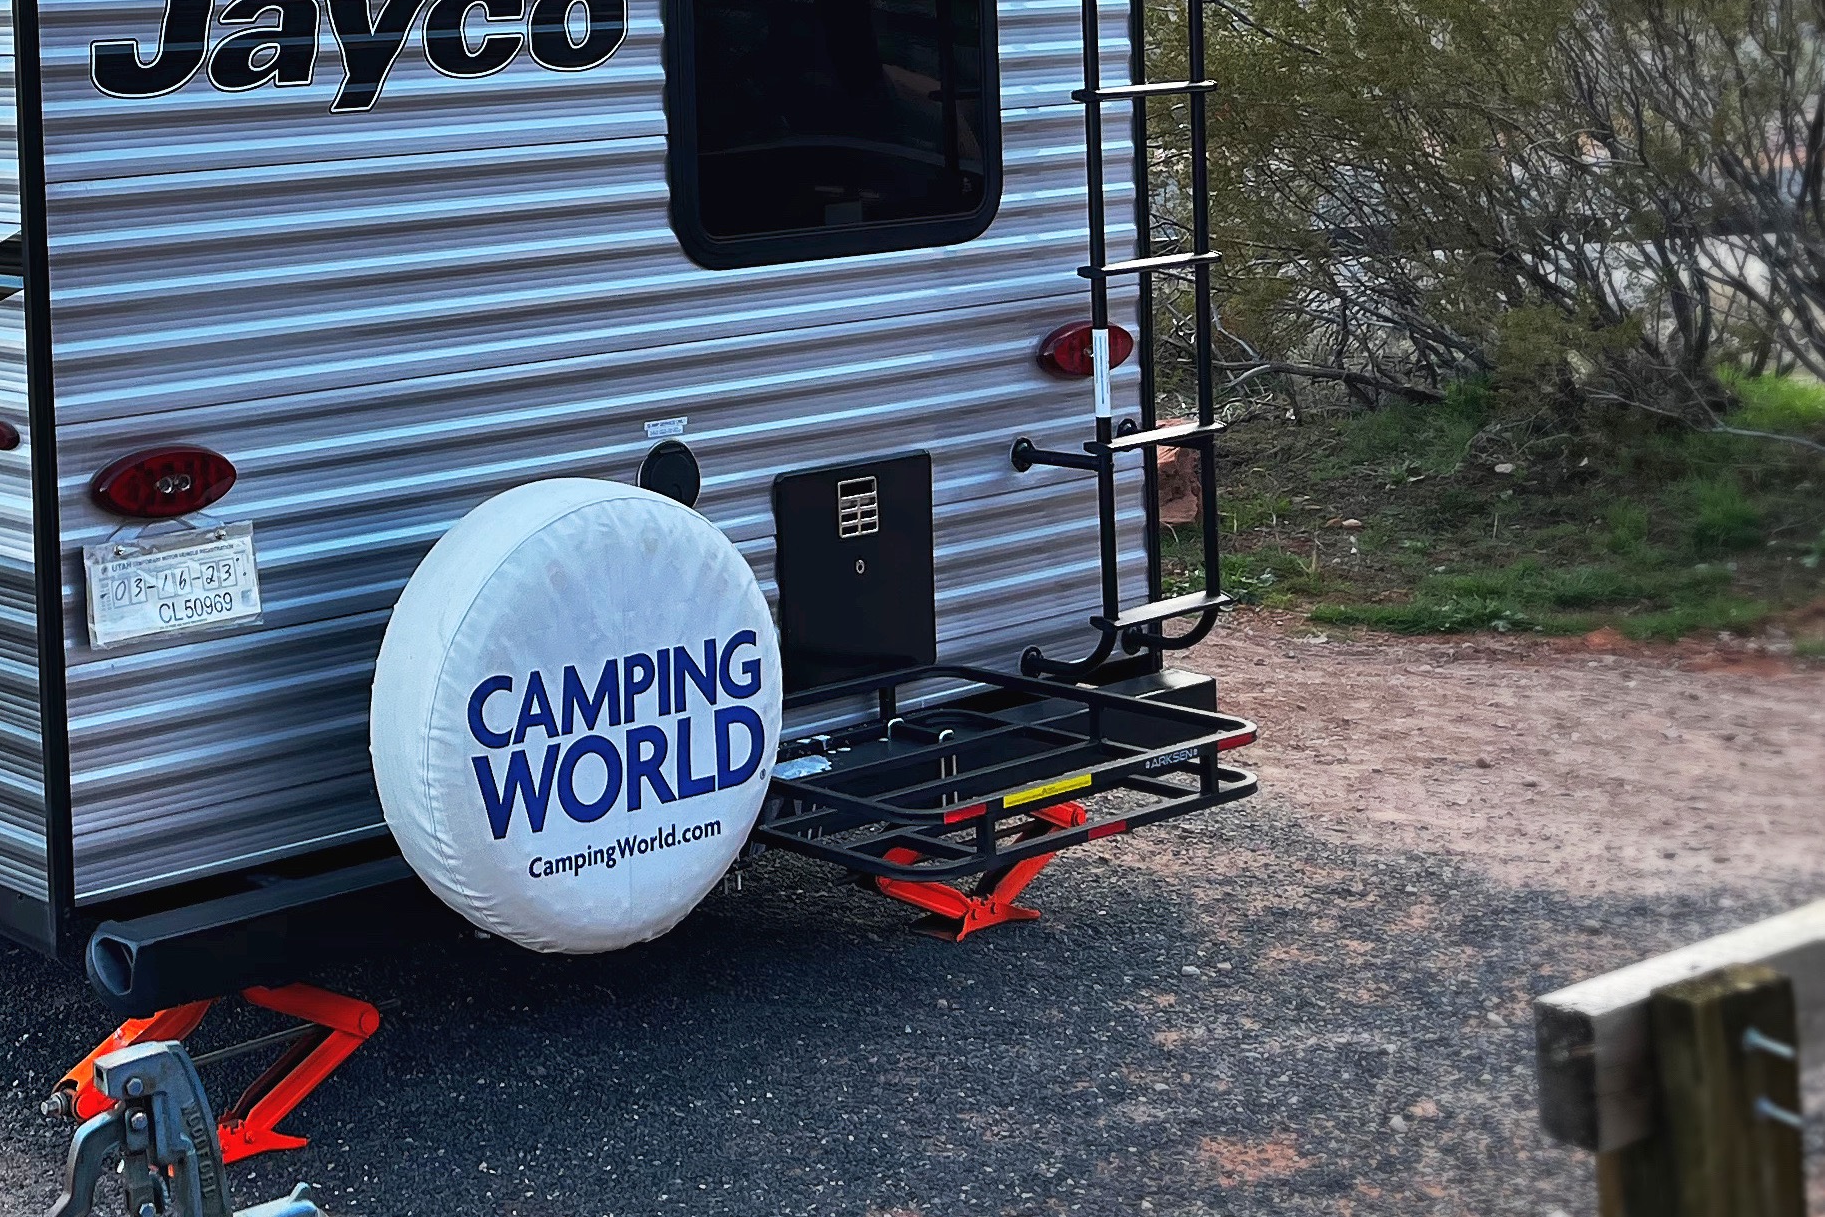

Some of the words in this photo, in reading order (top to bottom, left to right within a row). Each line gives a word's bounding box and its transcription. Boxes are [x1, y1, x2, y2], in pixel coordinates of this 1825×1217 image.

[112, 561, 132, 572] UTAH
[467, 629, 763, 748] CAMPING
[472, 705, 765, 840] WORLD
[1151, 748, 1193, 768] ARKSEN
[528, 818, 722, 877] CampingWorld.com
